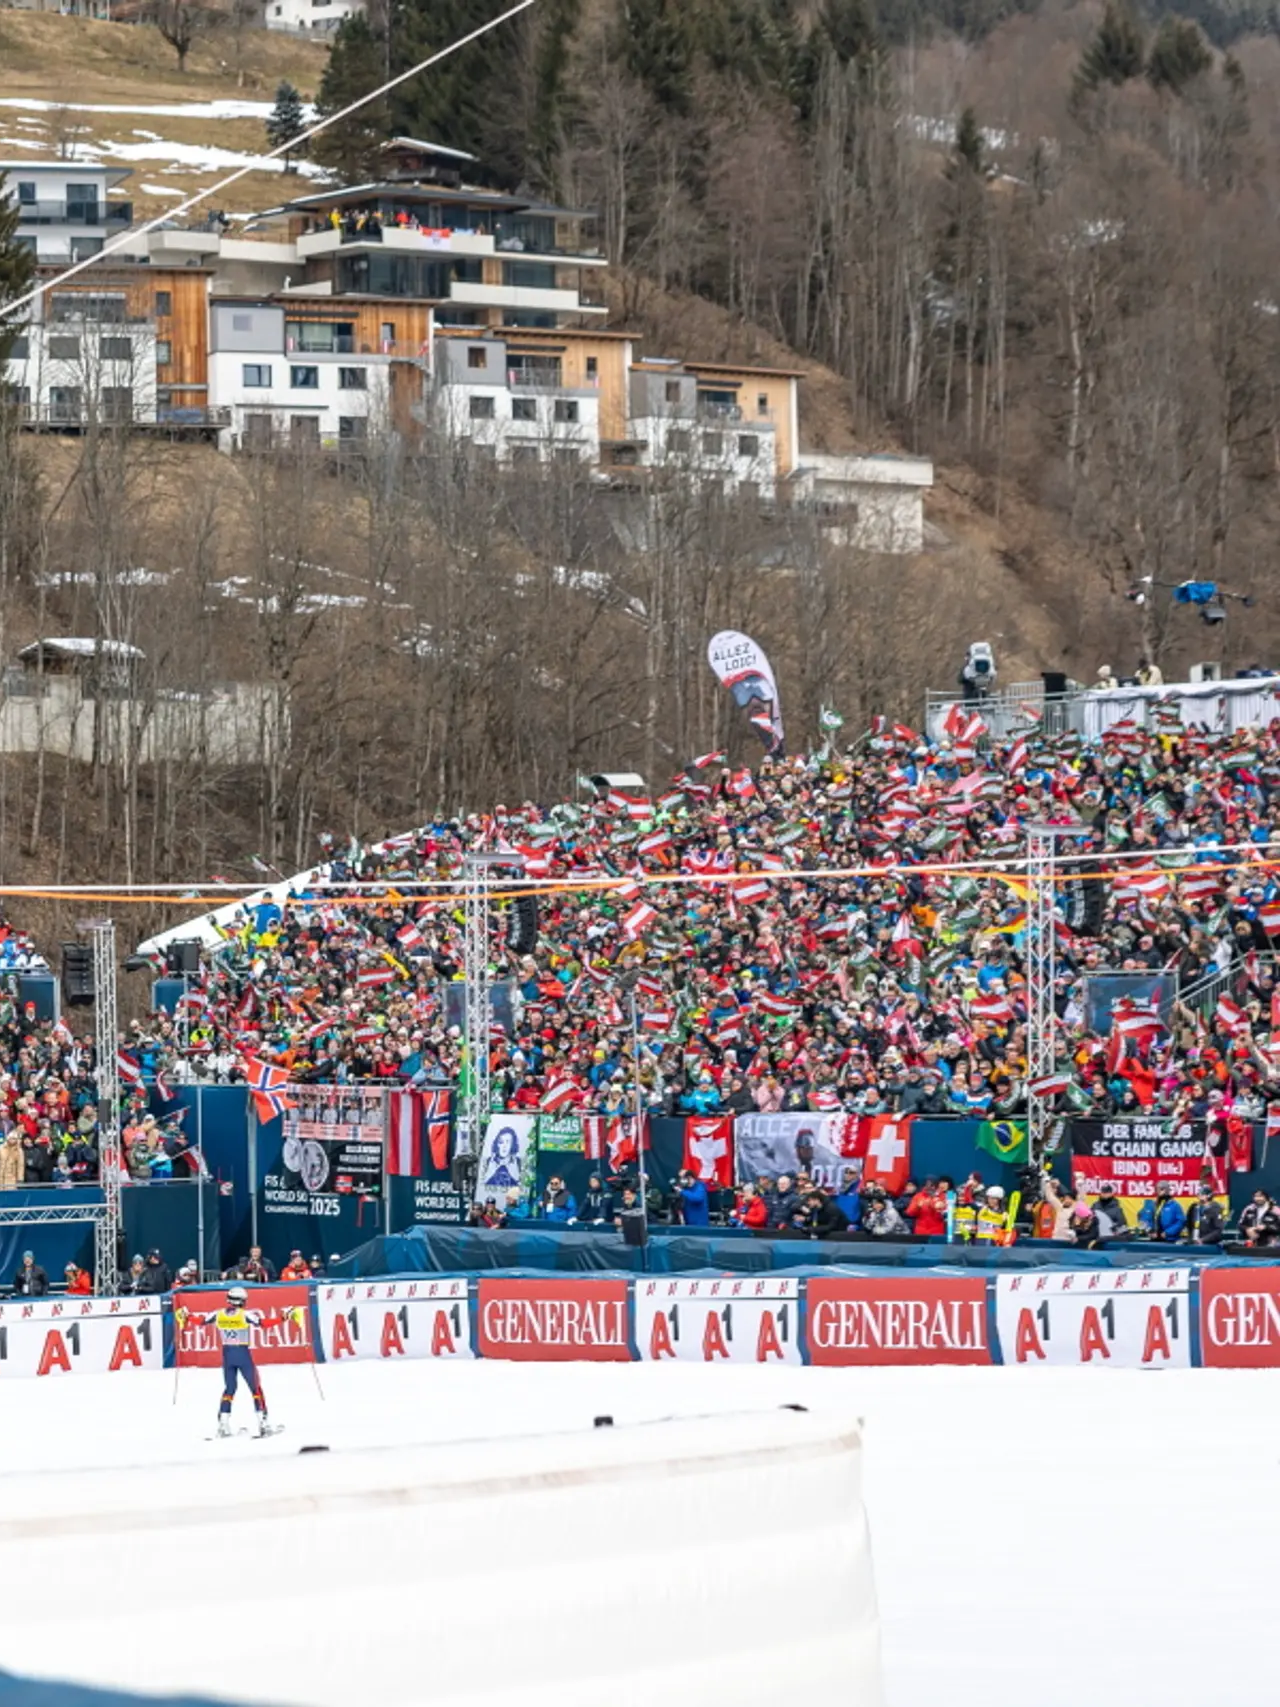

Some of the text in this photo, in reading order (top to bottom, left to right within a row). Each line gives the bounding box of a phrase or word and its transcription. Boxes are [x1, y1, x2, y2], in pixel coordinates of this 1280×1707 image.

[713, 642, 750, 661] ALLEZ
[1103, 1123, 1130, 1139] DER
[1092, 1141, 1205, 1157] SC CHAIN GANG
[264, 1175, 279, 1187] FIS
[1127, 1180, 1156, 1196] DAS
[264, 1190, 296, 1202] WORLD
[415, 1196, 460, 1208] WORLD SKI
[309, 1197, 341, 1216] 2025
[332, 1303, 461, 1359] A1 A1 A1
[484, 1299, 626, 1346] GENERALI
[812, 1300, 987, 1350] GENERALI
[1016, 1297, 1178, 1362] A1 A1 A1
[651, 1303, 788, 1362] A1 A1 A1
[37, 1322, 80, 1376] A1
[109, 1318, 152, 1371] A1
